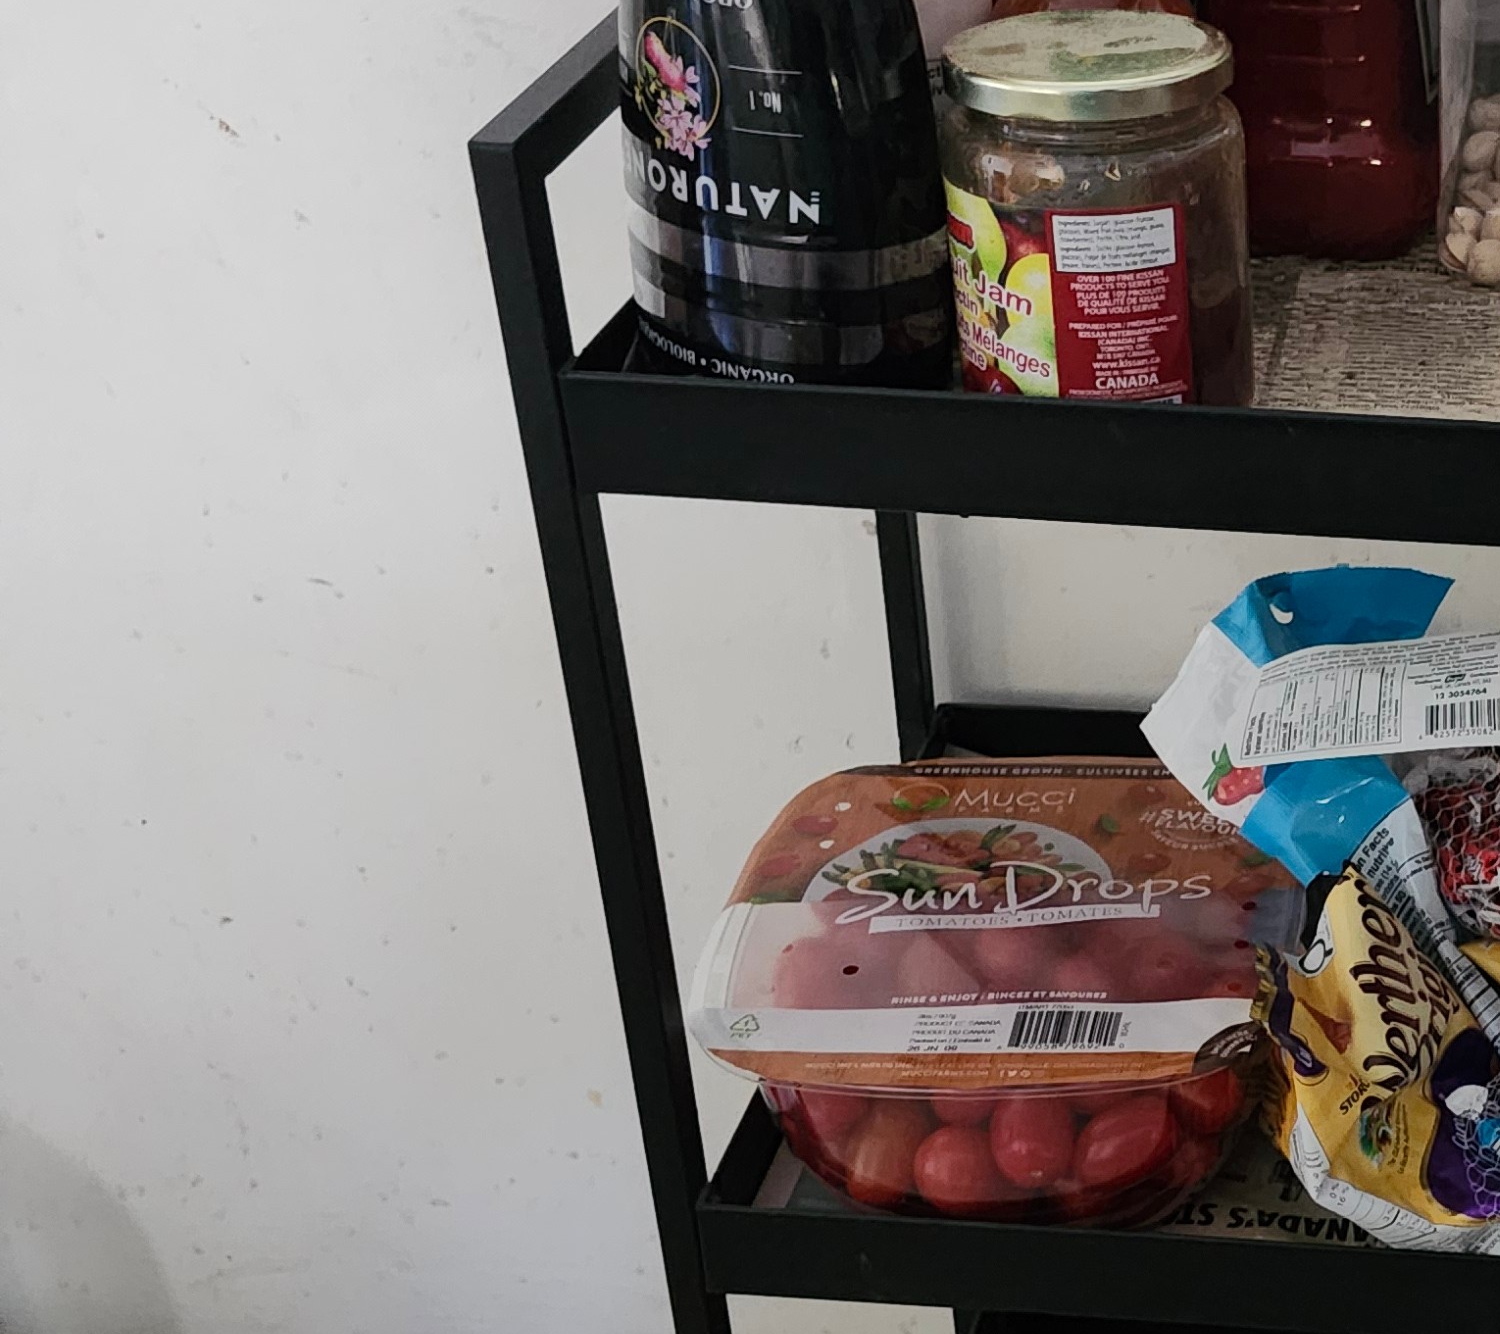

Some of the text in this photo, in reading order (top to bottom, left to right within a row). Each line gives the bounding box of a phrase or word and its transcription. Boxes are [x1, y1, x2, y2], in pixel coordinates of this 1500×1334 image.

[759, 92, 782, 114] No.
[1070, 282, 1115, 291] PRODUCTS
[1077, 275, 1099, 283] OVER
[974, 270, 1032, 317] Jam
[971, 322, 1051, 378] Mélanges
[1092, 356, 1161, 369] www.kissan.ca
[1095, 372, 1160, 389] CANADA
[1361, 827, 1390, 858] Facts
[834, 859, 1212, 924] Sun Drops
[895, 907, 1123, 929] TOMATOES TOMATES
[890, 995, 929, 1005] RINSE
[940, 992, 979, 1003] ENJOY
[987, 991, 1030, 1001] RINCEZ
[1032, 990, 1047, 999] ET
[1227, 1207, 1382, 1247] ANADA'S
